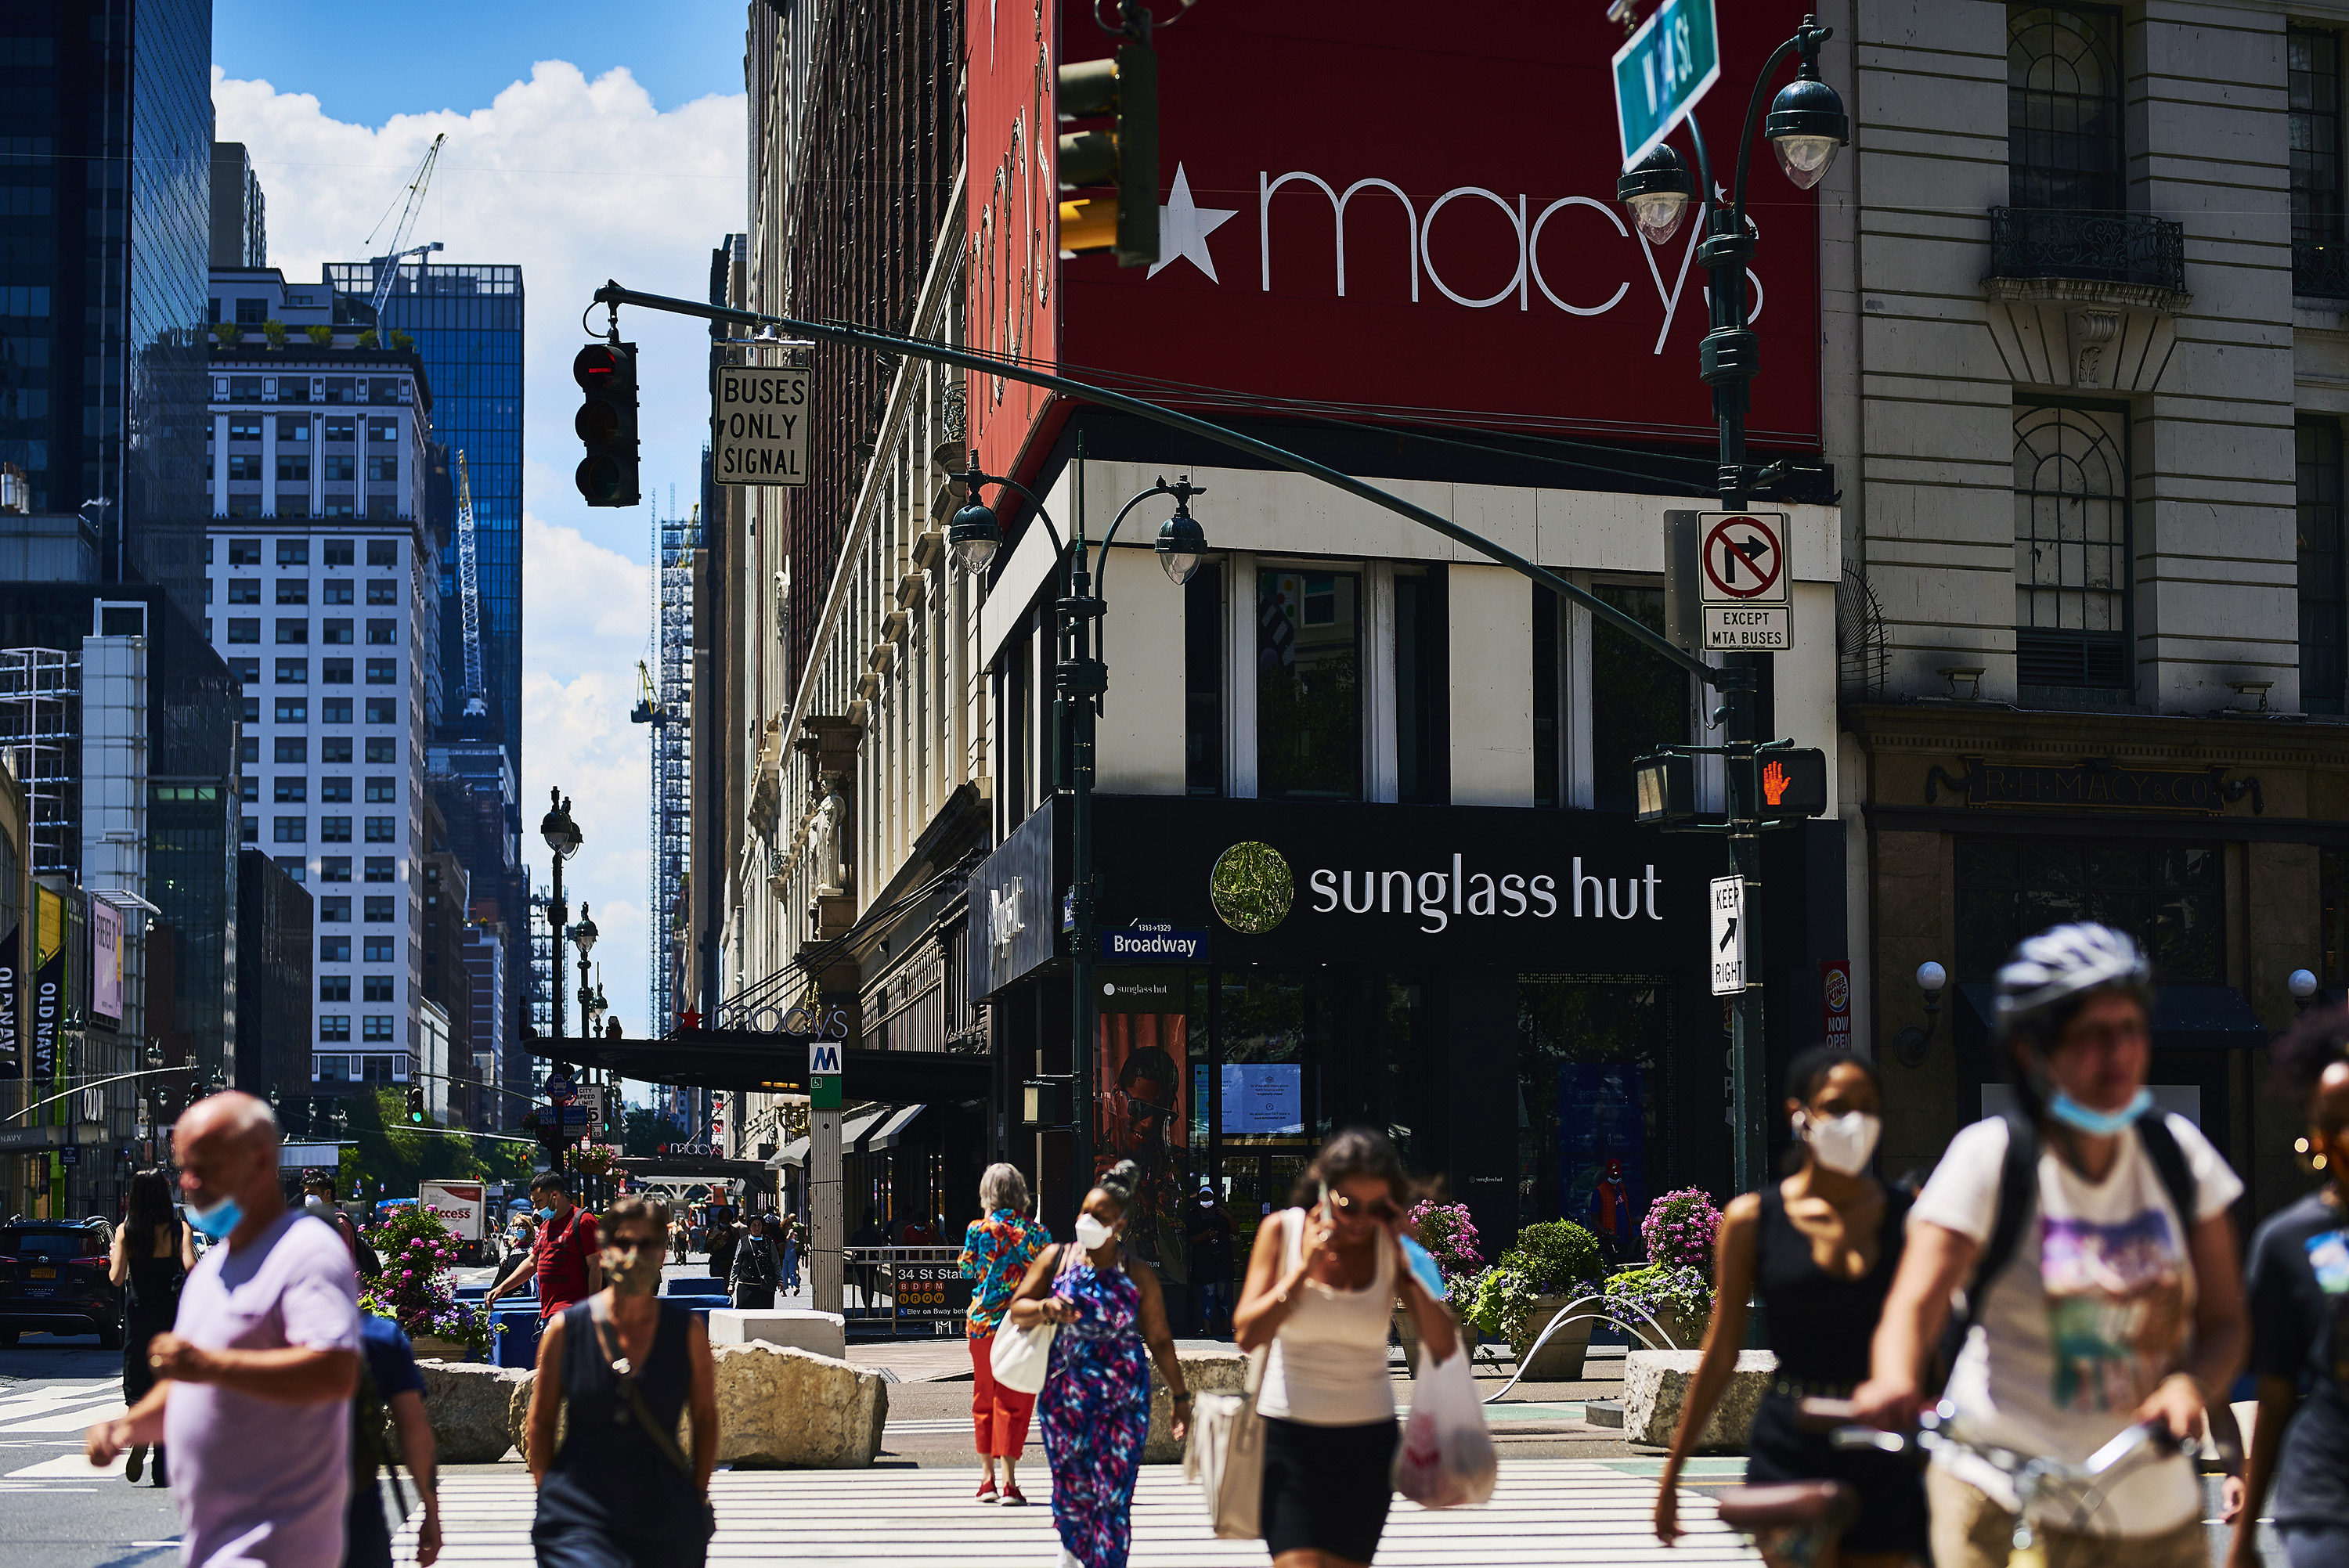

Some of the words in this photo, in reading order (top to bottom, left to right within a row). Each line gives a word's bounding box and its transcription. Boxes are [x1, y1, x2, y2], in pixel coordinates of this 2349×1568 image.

[724, 377, 806, 405] BUSES
[730, 413, 798, 440] ONLY
[723, 448, 800, 475] SIGNAL
[1723, 612, 1770, 625] EXCEPT
[1712, 632, 1736, 644] MTA
[1741, 632, 1781, 644] BUSES
[1310, 852, 1557, 933] sunglass
[1573, 856, 1662, 921] hut
[1716, 886, 1739, 910] KEEP
[1114, 934, 1196, 957] Broadway
[1716, 961, 1743, 983] RIGHT
[1117, 984, 1153, 995] sunglass
[1153, 984, 1167, 993] hut
[1827, 976, 1846, 993] BURGER
[1828, 983, 1847, 1003] KING
[39, 982, 56, 1018] OLD
[1828, 1016, 1848, 1032] NOW
[37, 1022, 54, 1072] NAVY
[1826, 1033, 1850, 1049] OPEN
[0, 1134, 22, 1143] NAVY
[438, 1209, 471, 1219] ccess
[898, 1269, 915, 1280] 34
[919, 1269, 933, 1280] St
[938, 1269, 976, 1280] Statn
